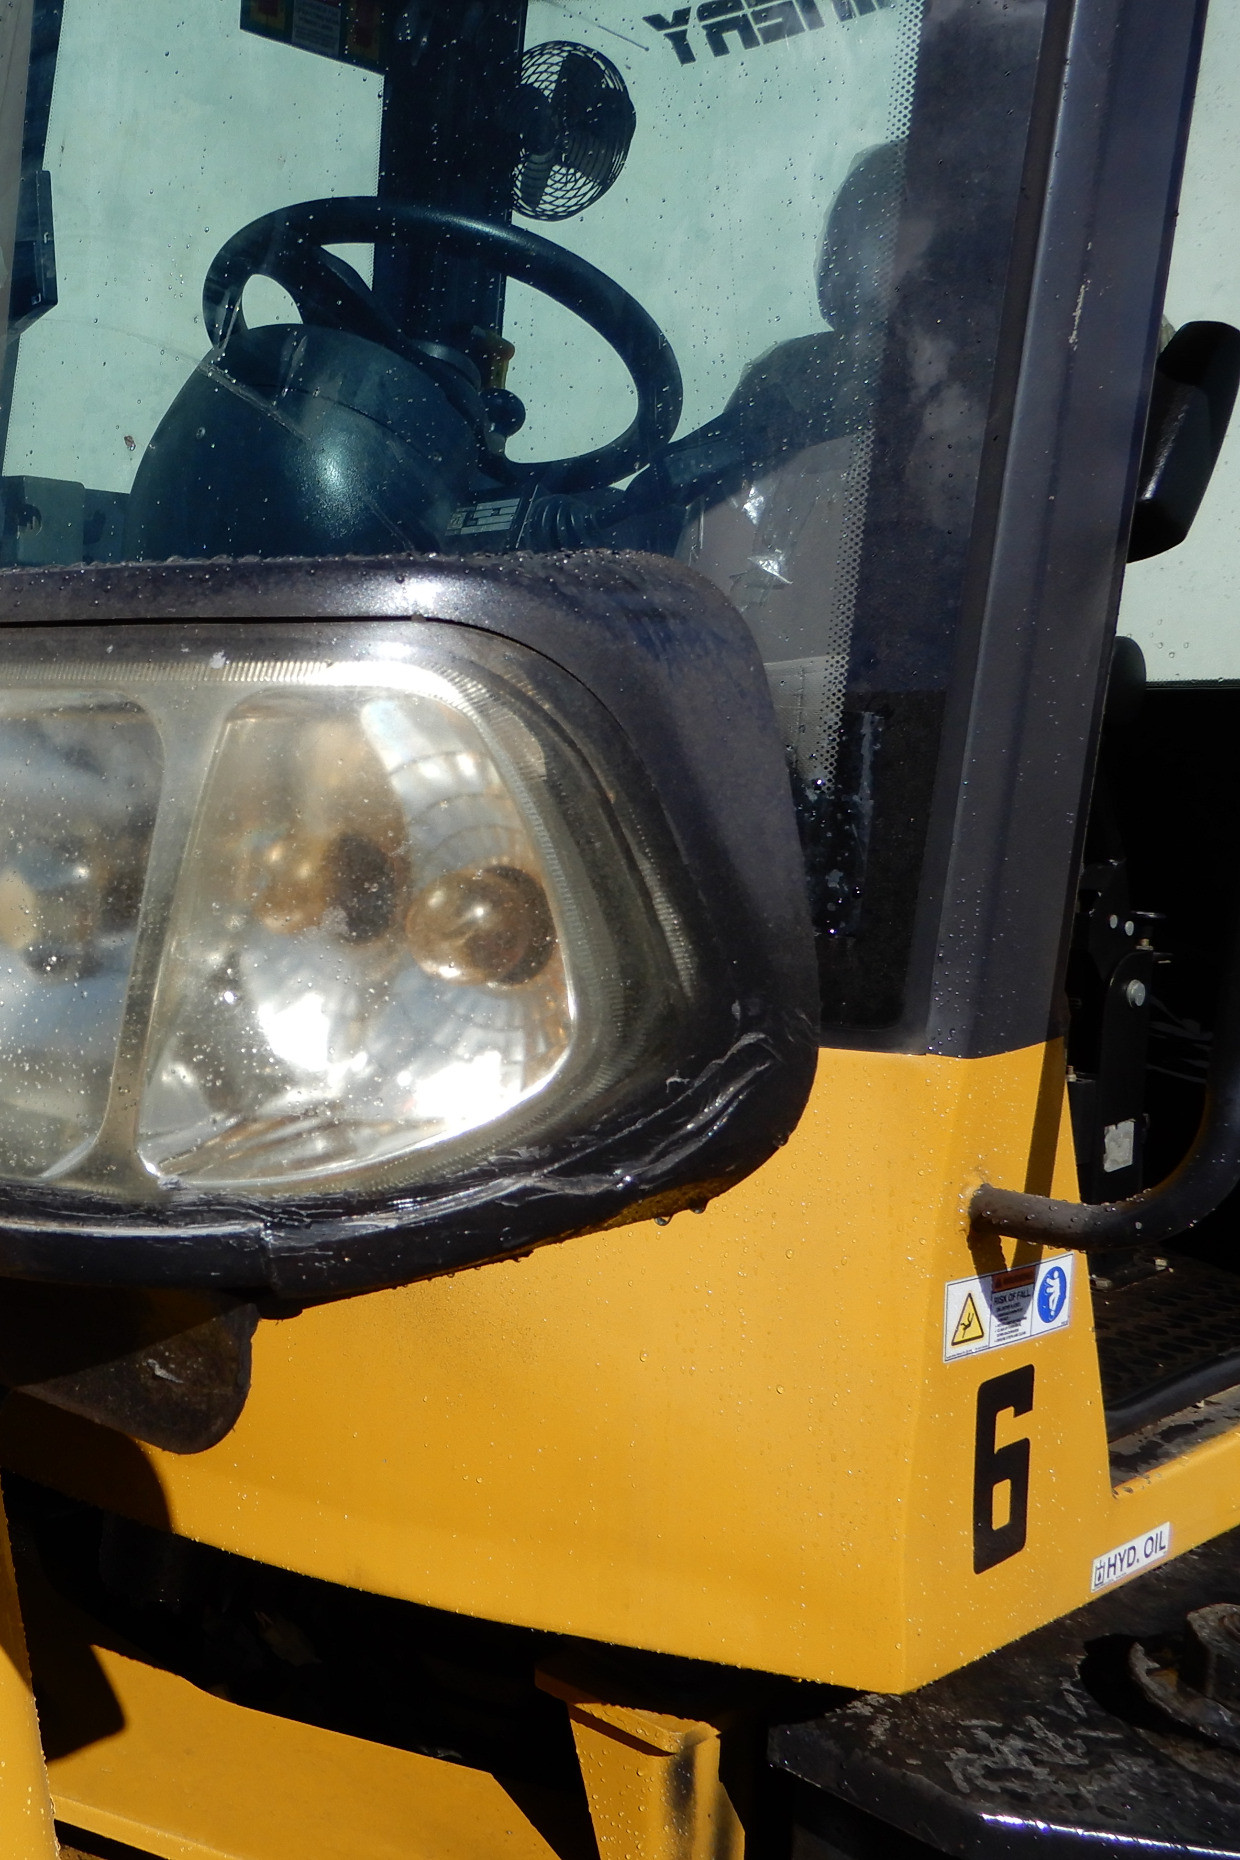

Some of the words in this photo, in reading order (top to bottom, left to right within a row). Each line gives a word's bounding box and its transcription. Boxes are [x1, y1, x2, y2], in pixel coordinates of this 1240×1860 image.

[994, 1294, 1008, 1304] RISK
[1008, 1292, 1017, 1302] OF
[1017, 1289, 1031, 1300] FALL
[973, 1364, 1035, 1575] 6
[1106, 1545, 1139, 1579] HYD.
[1143, 1530, 1166, 1559] OIL
